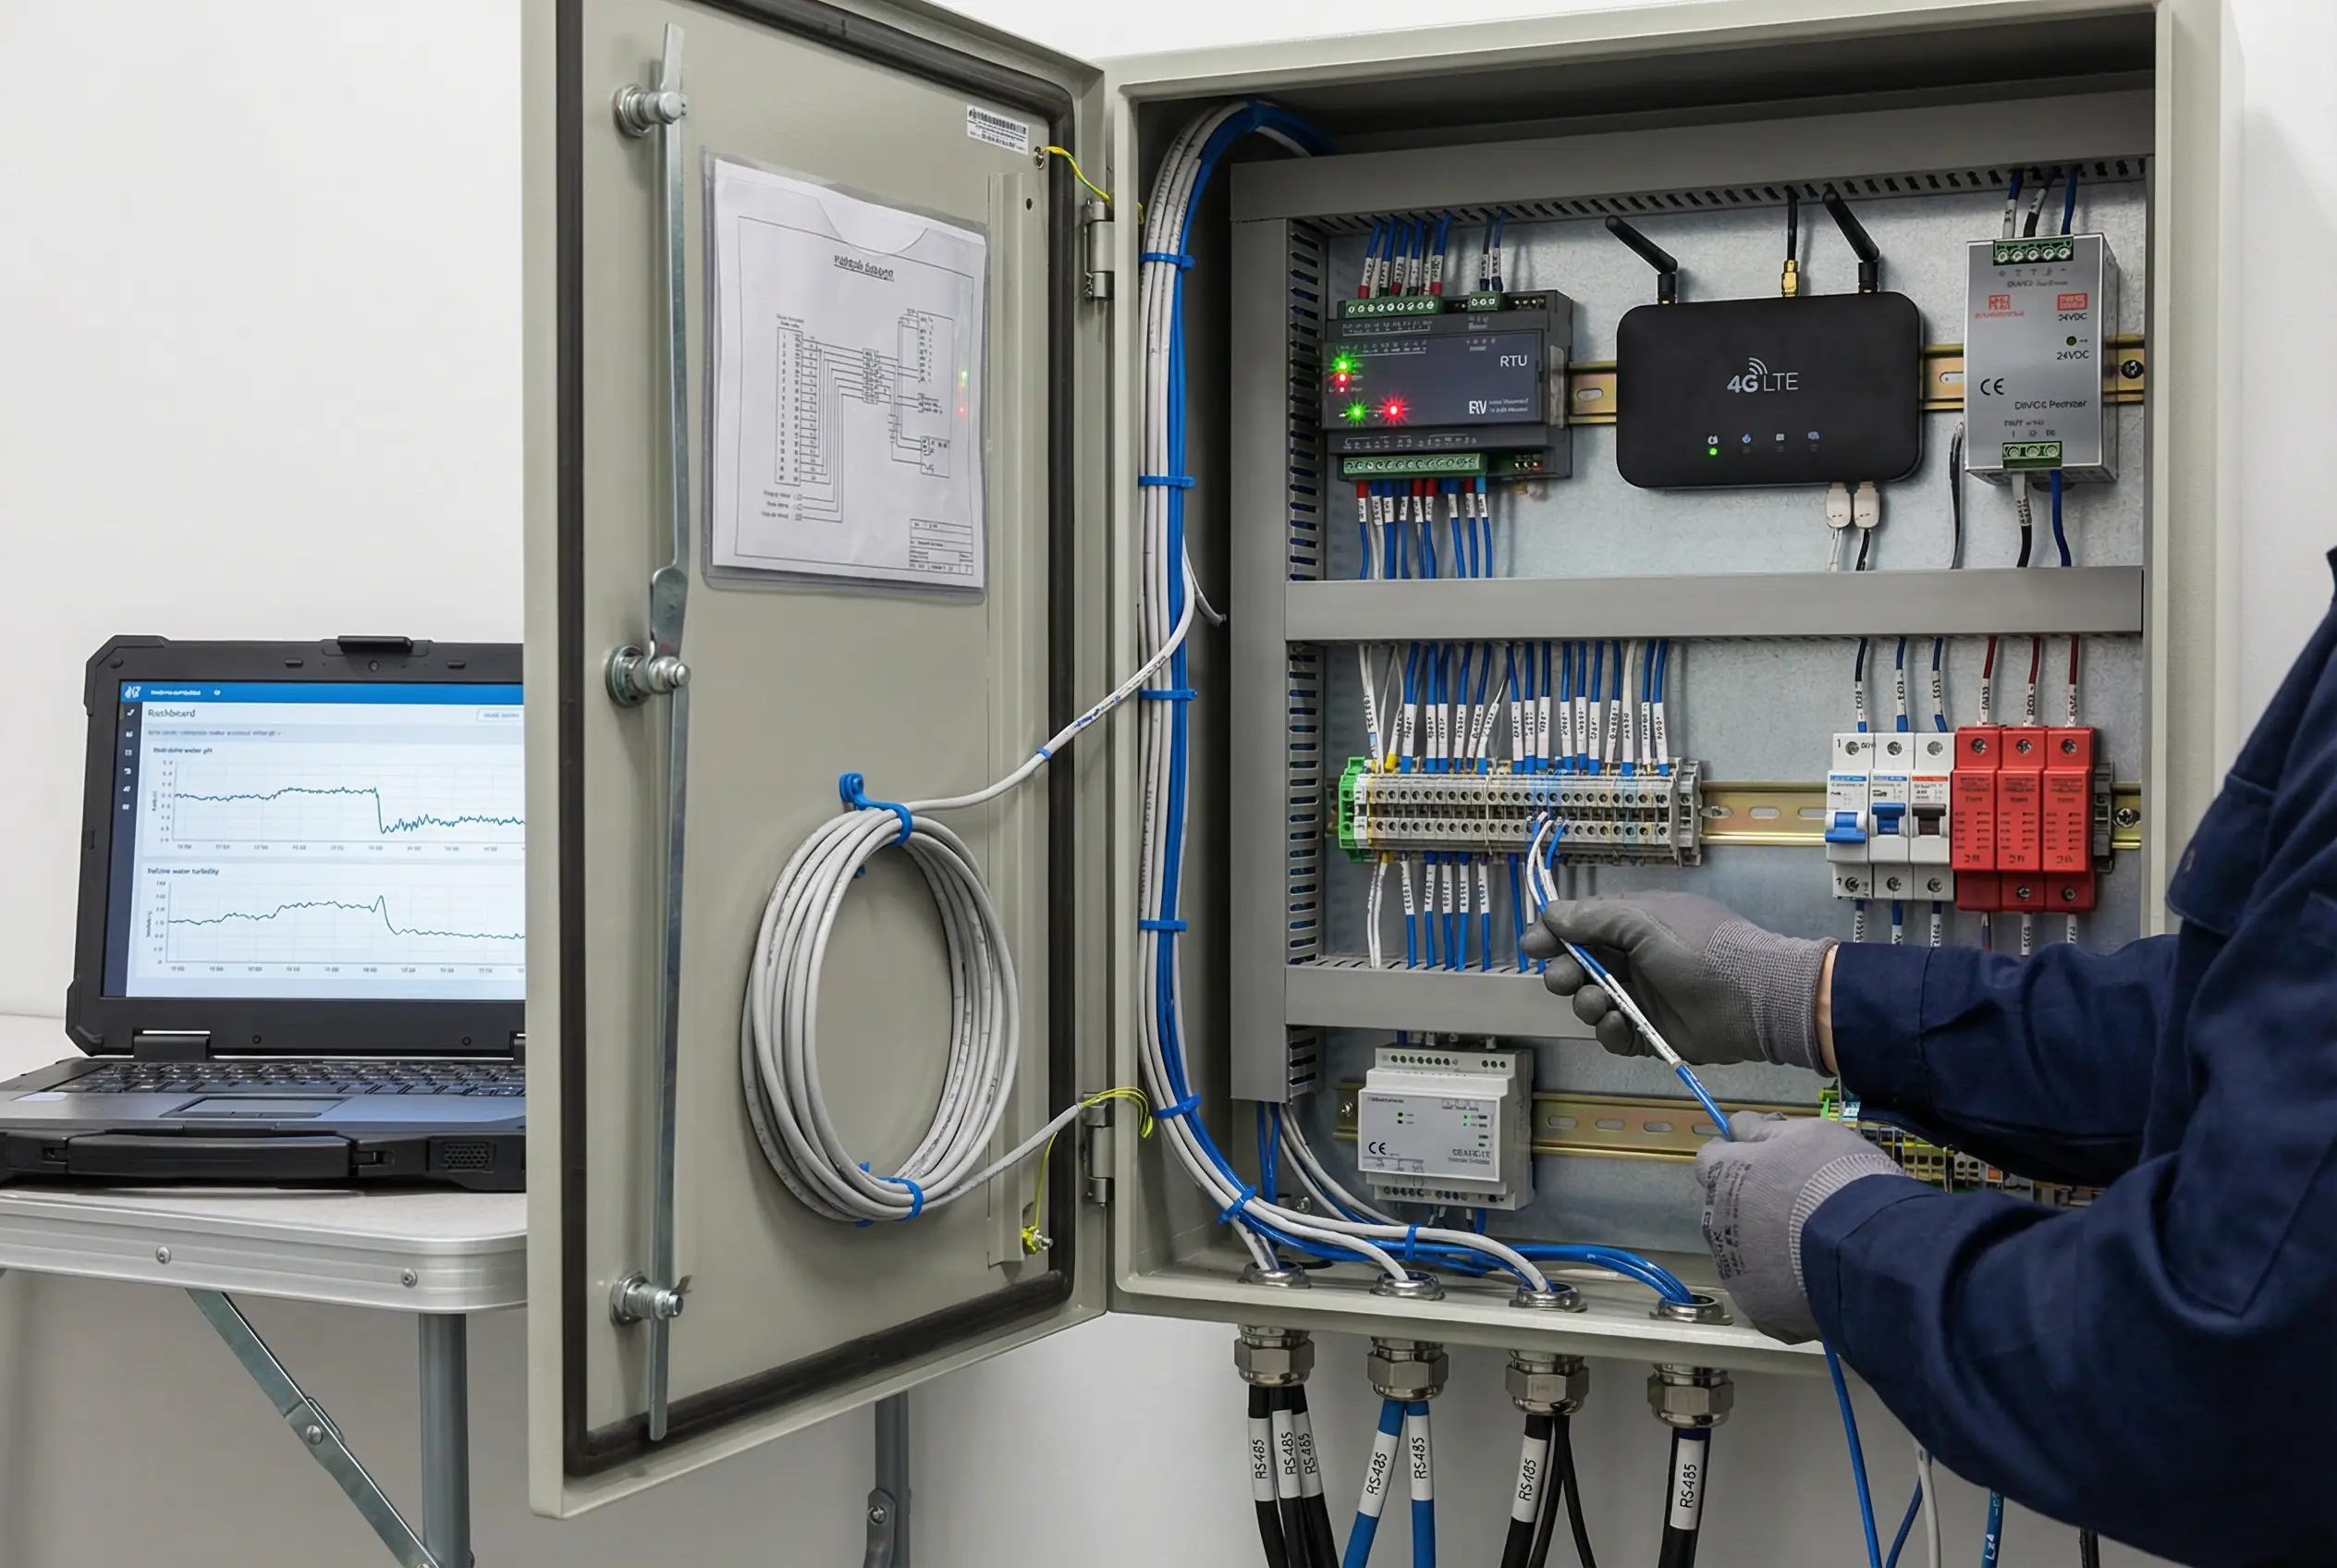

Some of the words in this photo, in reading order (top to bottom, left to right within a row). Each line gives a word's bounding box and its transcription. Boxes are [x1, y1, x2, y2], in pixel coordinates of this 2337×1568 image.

[1499, 354, 1528, 367] RTU
[1726, 374, 1758, 393] 4G
[1763, 372, 1799, 391] LTE
[1980, 378, 2004, 396] CE
[1253, 1439, 1269, 1479] RS485
[1281, 1431, 1298, 1476] RS485
[1298, 1433, 1317, 1476] RS485
[1365, 1452, 1389, 1496] RS485
[1411, 1436, 1428, 1480] RS485
[1679, 1464, 1698, 1509] RS485
